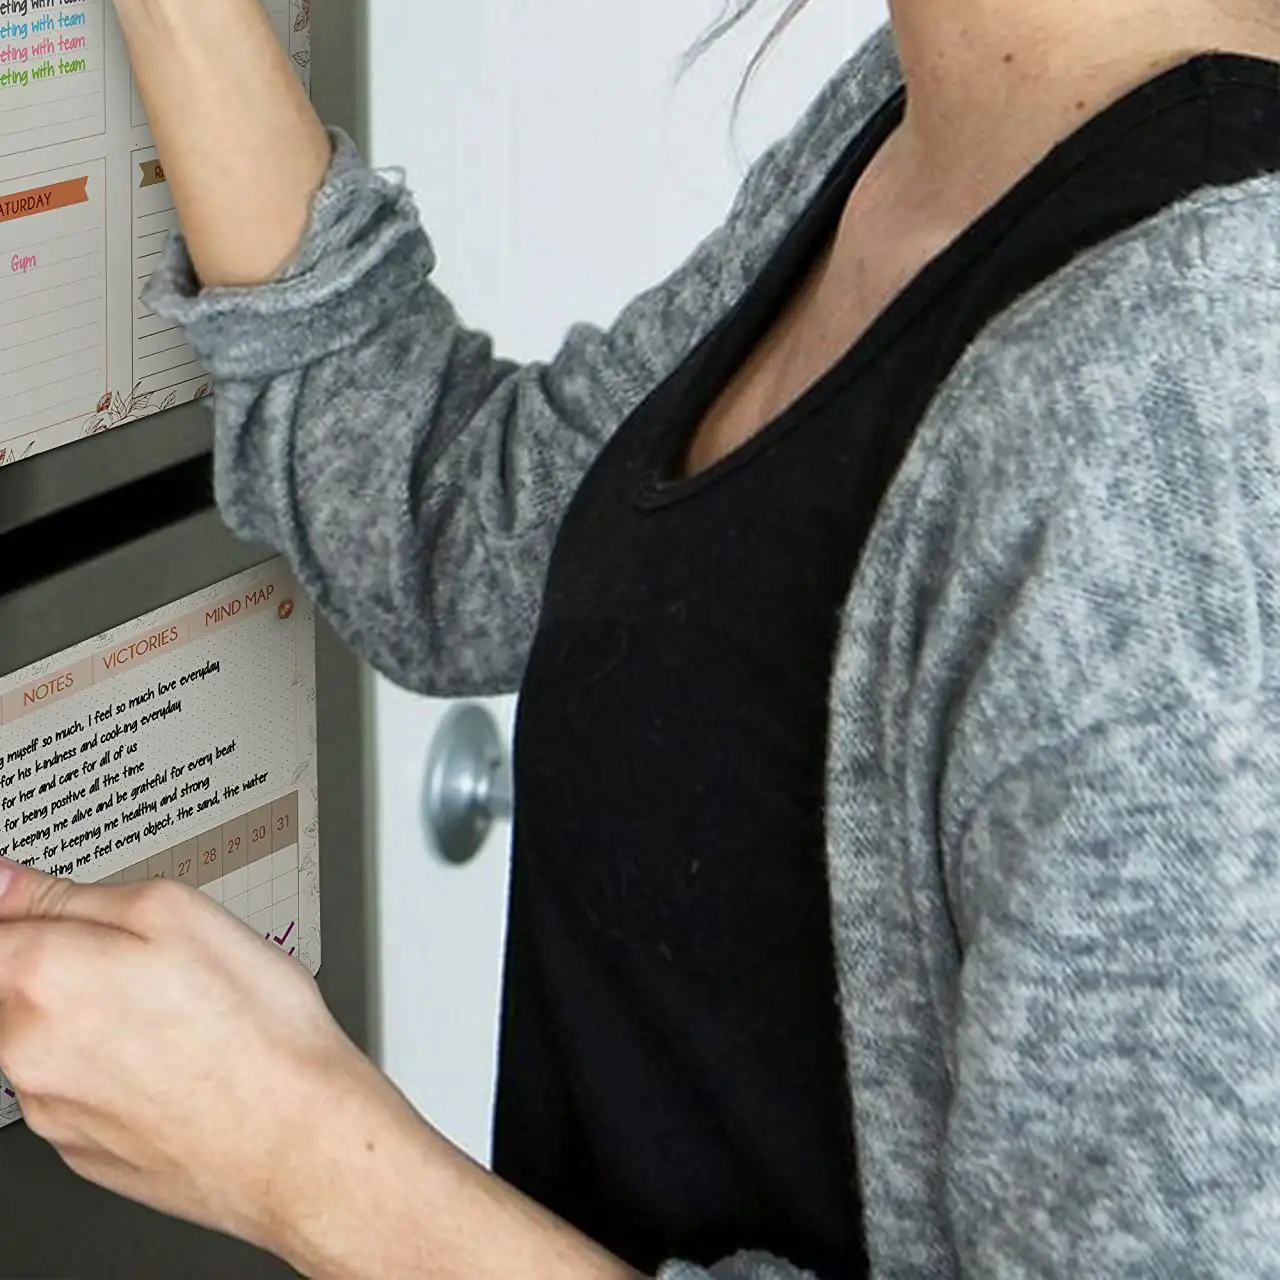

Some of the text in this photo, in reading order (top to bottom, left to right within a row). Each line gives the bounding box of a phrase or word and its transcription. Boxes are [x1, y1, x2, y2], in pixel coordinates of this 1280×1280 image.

[206, 585, 274, 626] MIND MAP
[103, 627, 178, 669] VICTORIES
[24, 673, 73, 706] NOTES
[277, 815, 288, 830] 31
[253, 826, 265, 842] 30
[228, 837, 240, 853] 29
[204, 848, 216, 864] 28
[179, 859, 191, 876] 27
